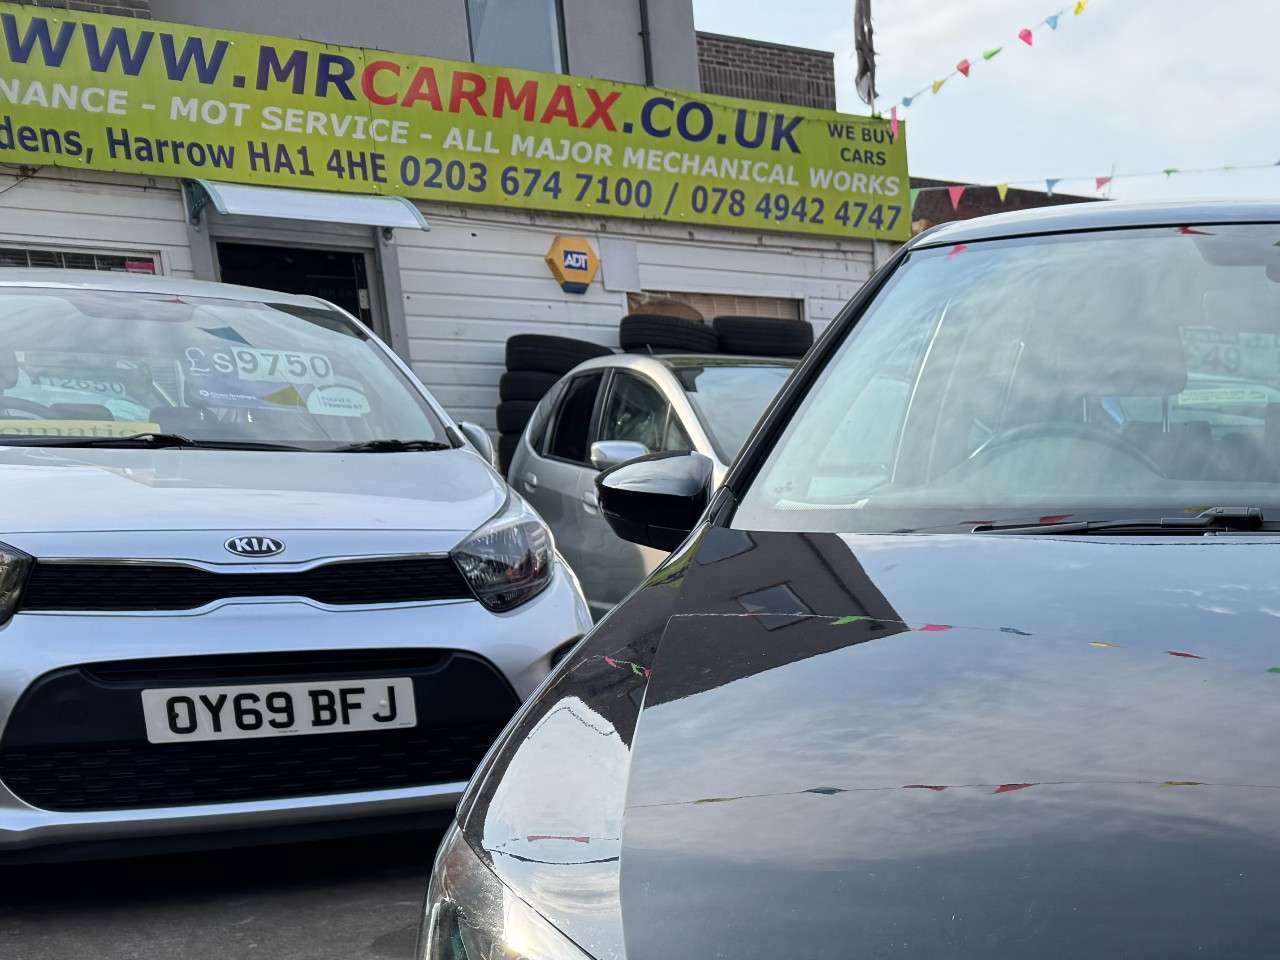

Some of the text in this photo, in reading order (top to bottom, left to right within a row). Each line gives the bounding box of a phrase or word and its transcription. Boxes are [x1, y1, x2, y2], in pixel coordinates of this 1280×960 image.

[1, 13, 804, 154] WWW.MRCARMAX.CO.UK
[0, 79, 128, 115] NANCE
[170, 97, 250, 126] MOT
[261, 106, 410, 144] SERVICE
[443, 127, 500, 154] ALL
[510, 134, 613, 166] MAJOR
[622, 147, 799, 186] MECHANICAL
[809, 167, 900, 197] WORKS
[827, 123, 895, 144] WE BUY
[840, 147, 886, 165] CARS
[106, 127, 234, 169] Harrow
[247, 141, 314, 176] HA1
[326, 149, 387, 183] 4HE
[400, 155, 487, 192] 0203
[501, 166, 561, 199] 674
[575, 173, 652, 208] 7100
[691, 185, 745, 216] 078
[755, 192, 824, 225] 4942
[834, 200, 902, 231] 4747
[564, 253, 588, 268] ADT
[233, 537, 277, 552] KIA
[166, 686, 397, 735] OY69 BFJ
